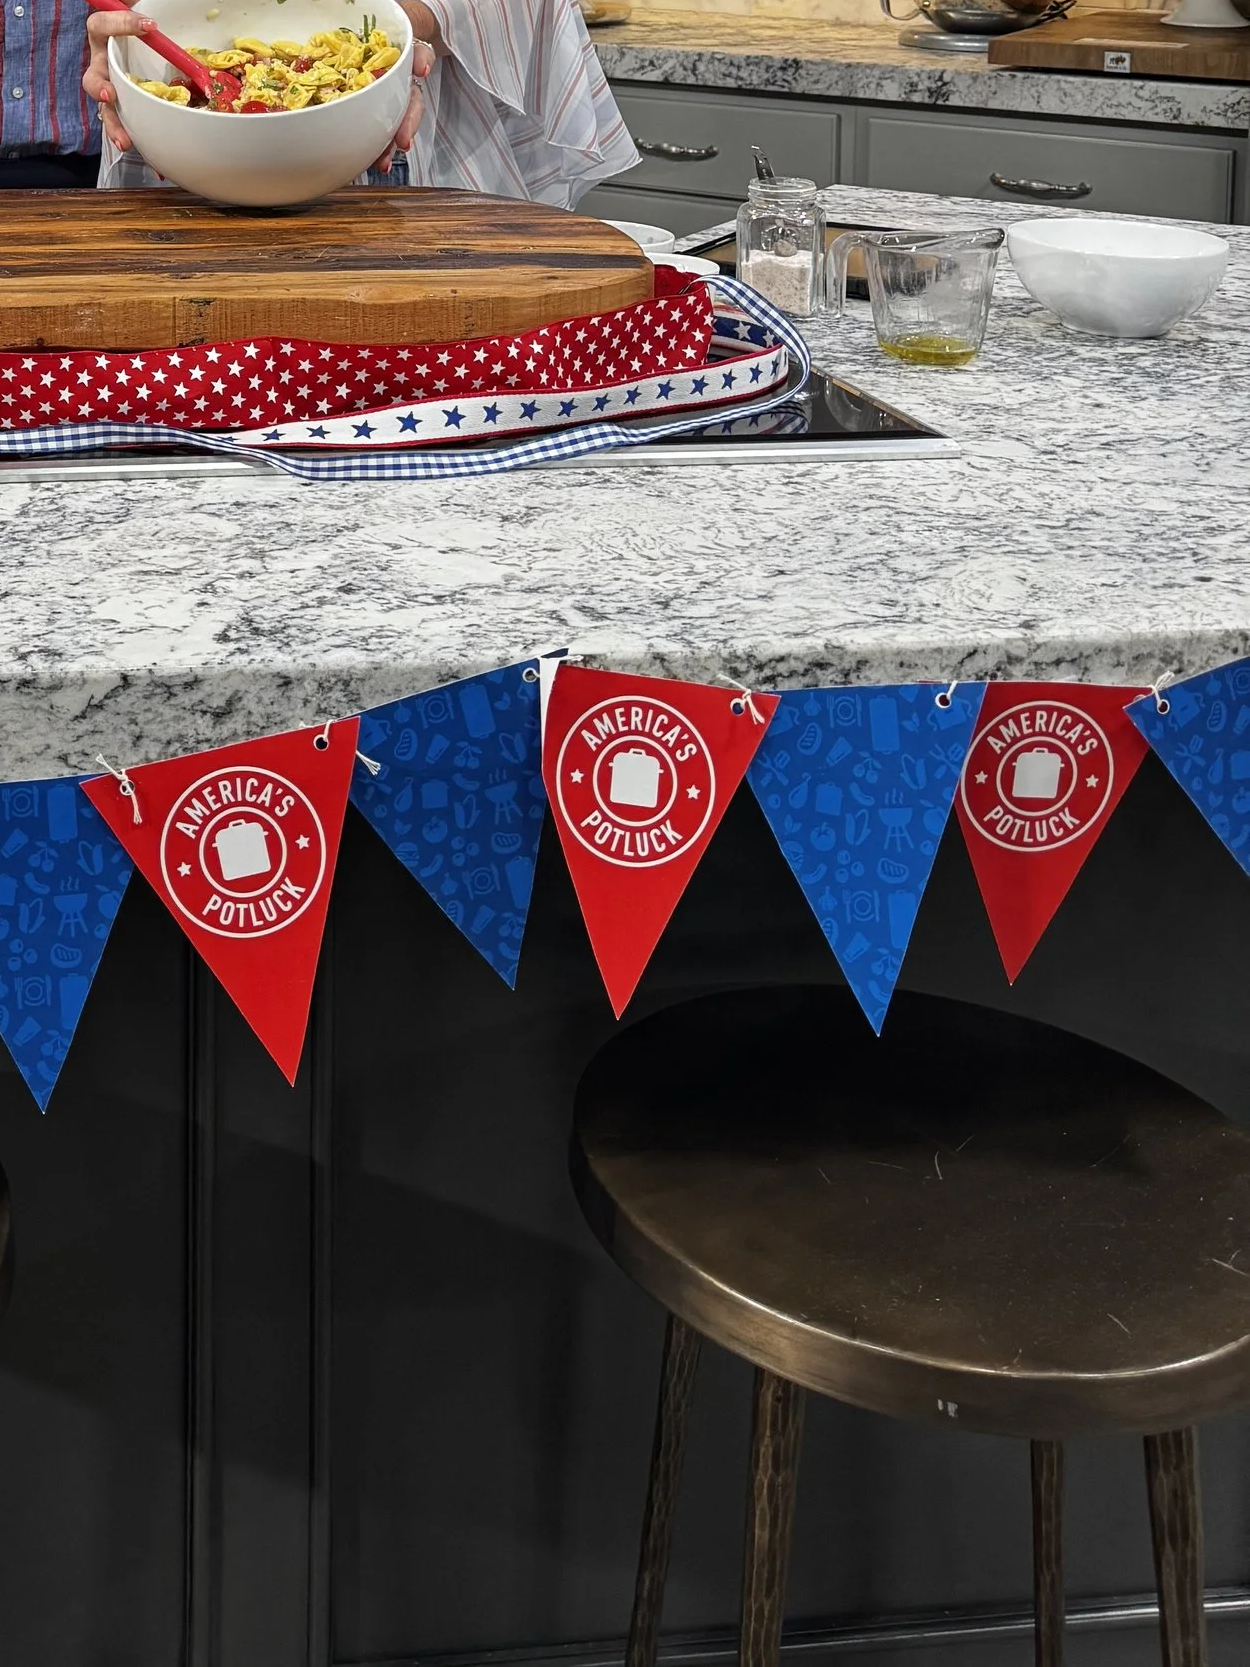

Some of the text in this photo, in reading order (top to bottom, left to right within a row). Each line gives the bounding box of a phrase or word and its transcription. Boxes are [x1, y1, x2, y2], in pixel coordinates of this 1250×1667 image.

[580, 706, 698, 762] AMERICA'S
[987, 710, 1098, 756] AMERICA'S
[175, 777, 295, 840] AMERICA'S
[580, 809, 684, 857] POTLUCK
[983, 805, 1080, 843] POTLUCK
[201, 876, 306, 928] POTLUCK
